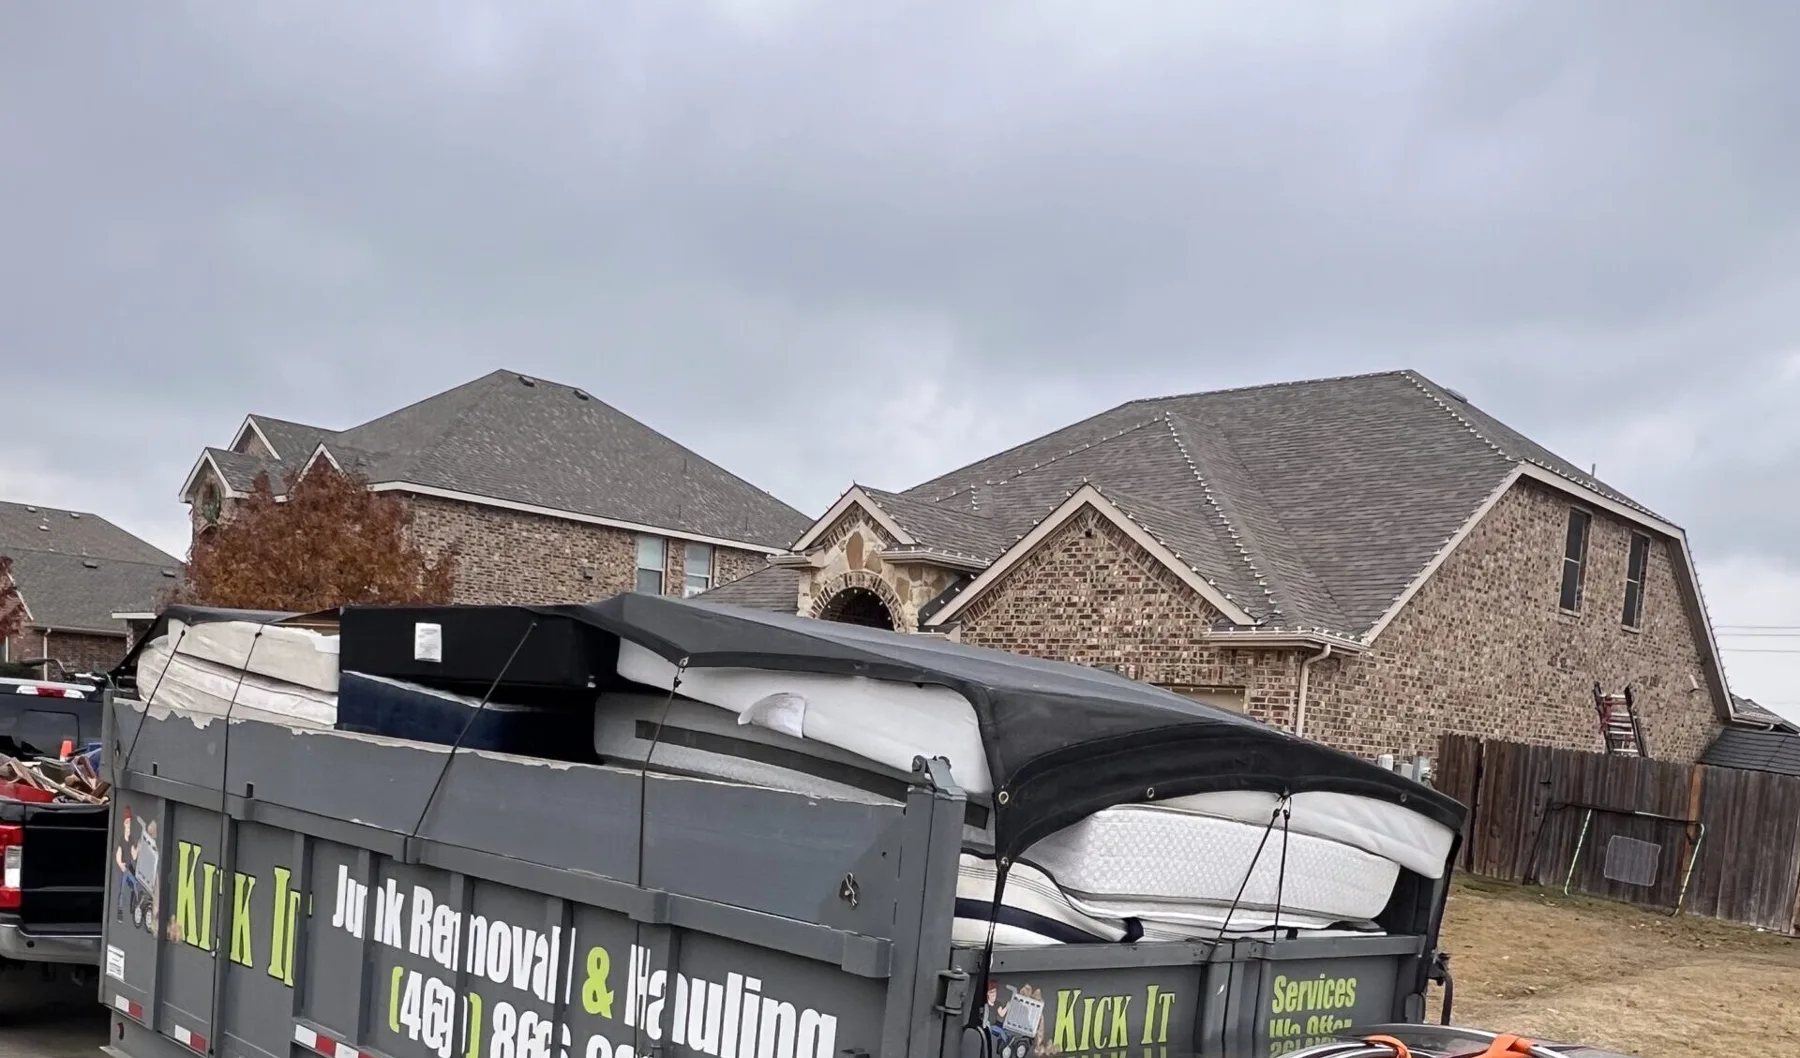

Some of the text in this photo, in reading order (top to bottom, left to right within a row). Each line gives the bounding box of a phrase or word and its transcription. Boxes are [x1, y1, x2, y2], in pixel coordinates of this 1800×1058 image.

[176, 840, 256, 968] KIK
[332, 864, 404, 949] Junk
[409, 885, 576, 1005] Removal
[582, 946, 615, 1019] &
[1053, 984, 1175, 1053] KICK IT
[1272, 973, 1357, 1014] Services
